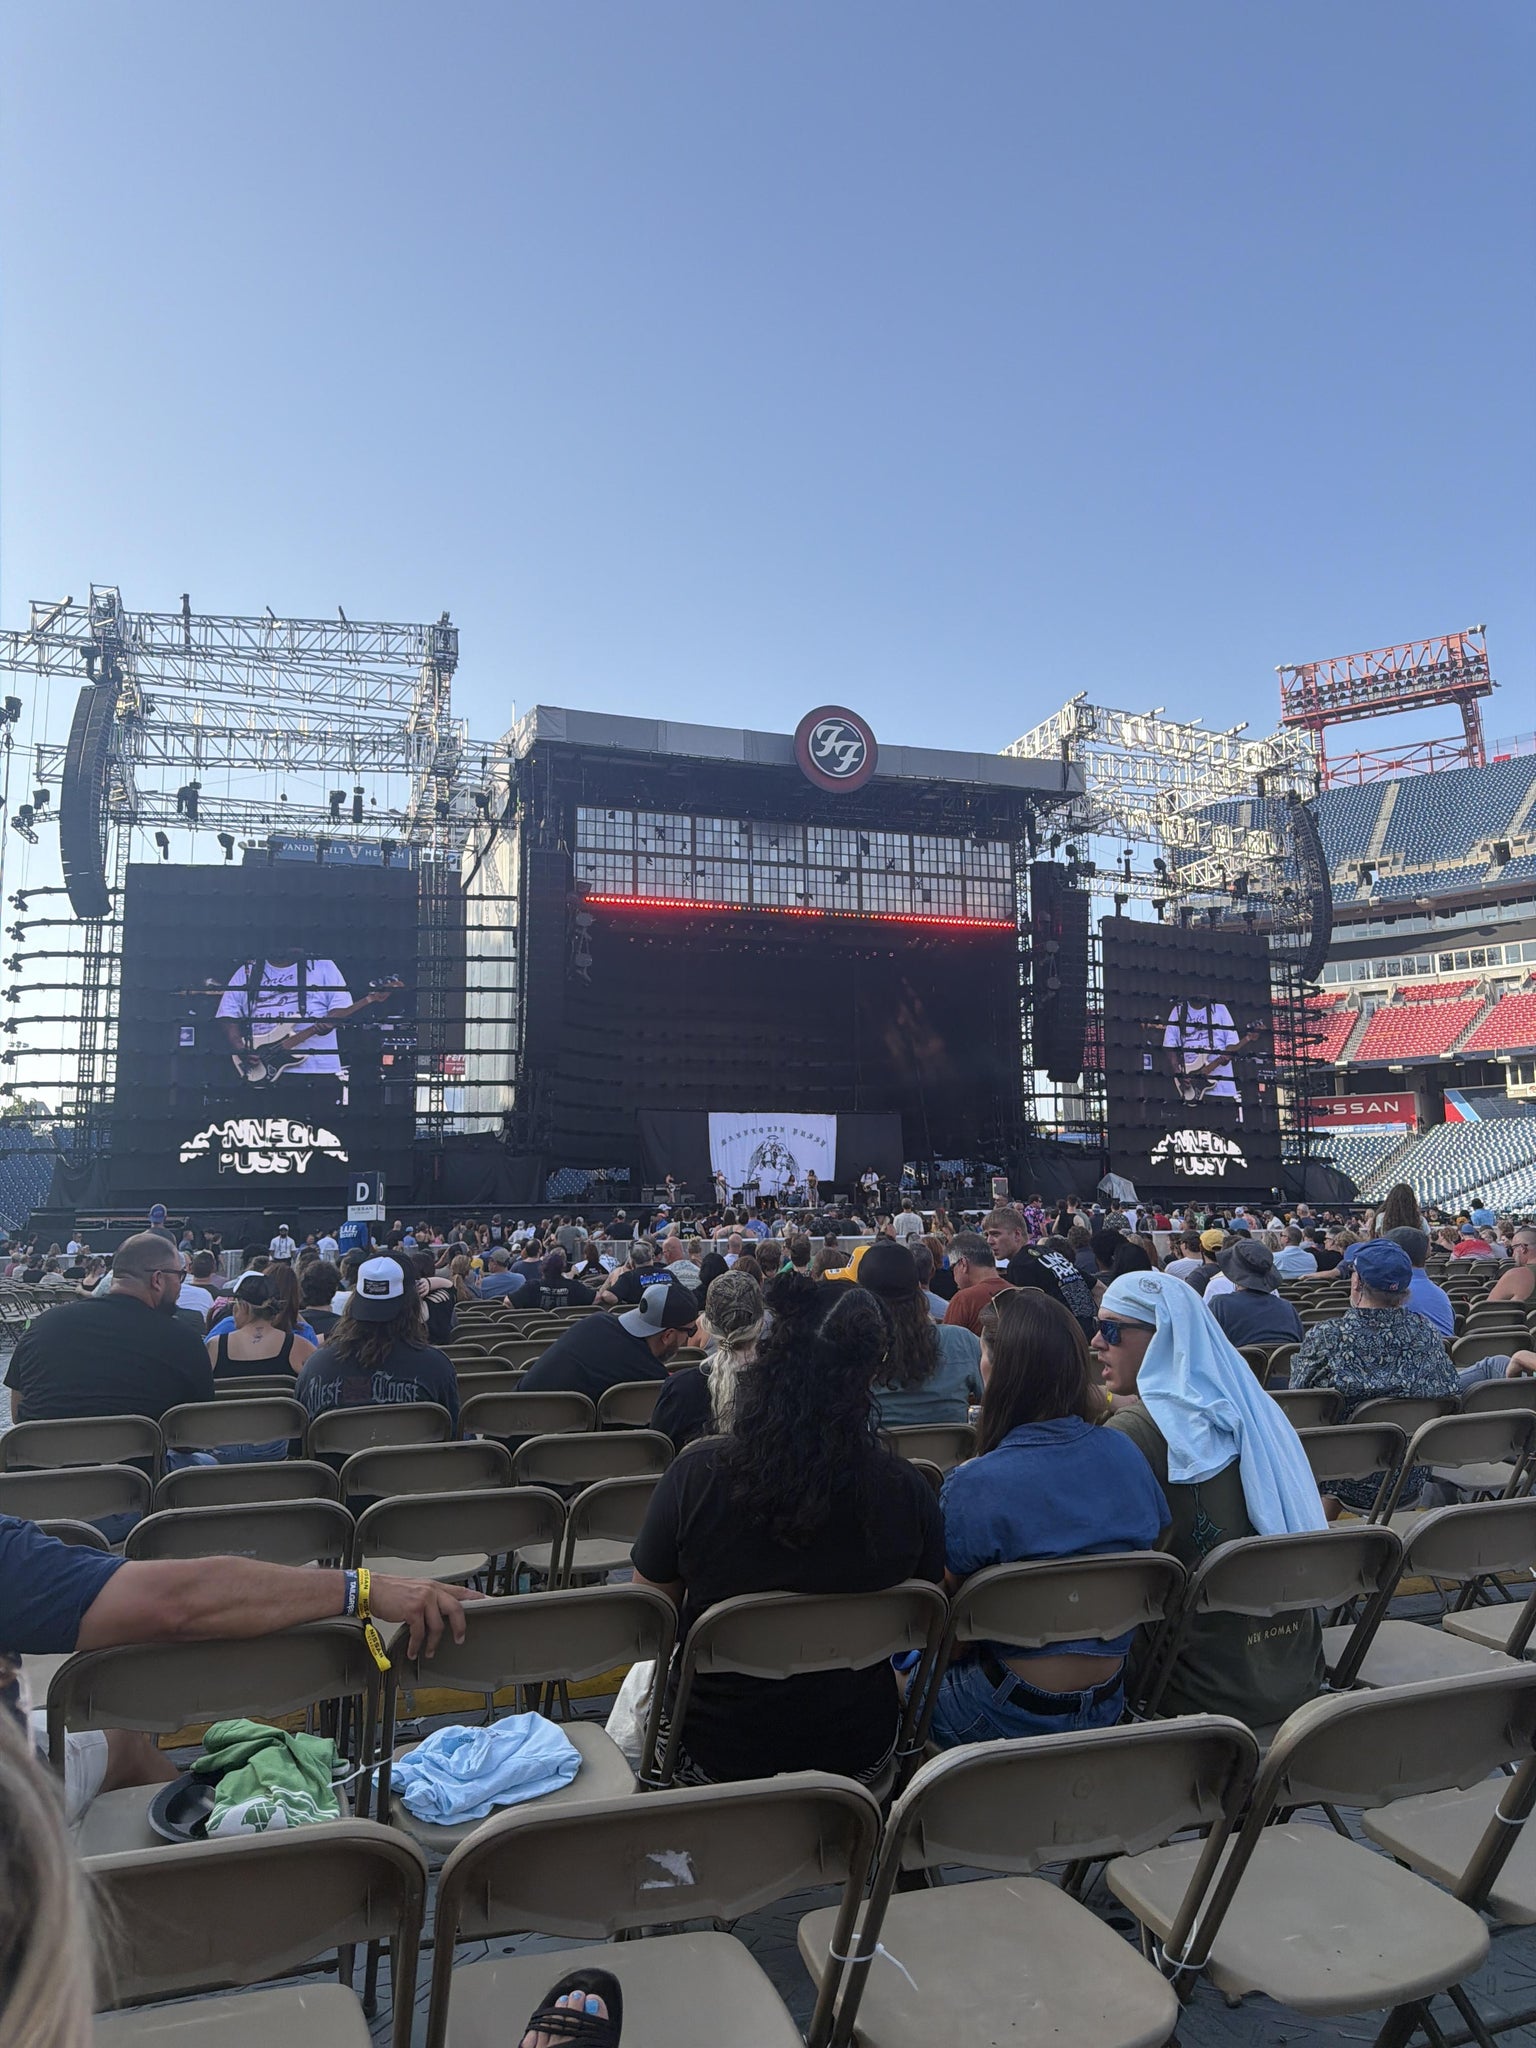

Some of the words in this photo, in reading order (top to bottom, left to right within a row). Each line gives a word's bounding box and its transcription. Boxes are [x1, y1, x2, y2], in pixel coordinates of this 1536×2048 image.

[282, 843, 345, 855] VANDEILT
[365, 849, 405, 859] HEATH
[1319, 1100, 1399, 1115] ISSAN
[218, 1149, 314, 1175] PUSSY
[1173, 1155, 1228, 1177] PUSSY
[355, 1182, 370, 1202] D
[370, 1628, 384, 1658] NISSAN
[1247, 1632, 1261, 1646] NEW
[1264, 1621, 1298, 1639] ROMAN
